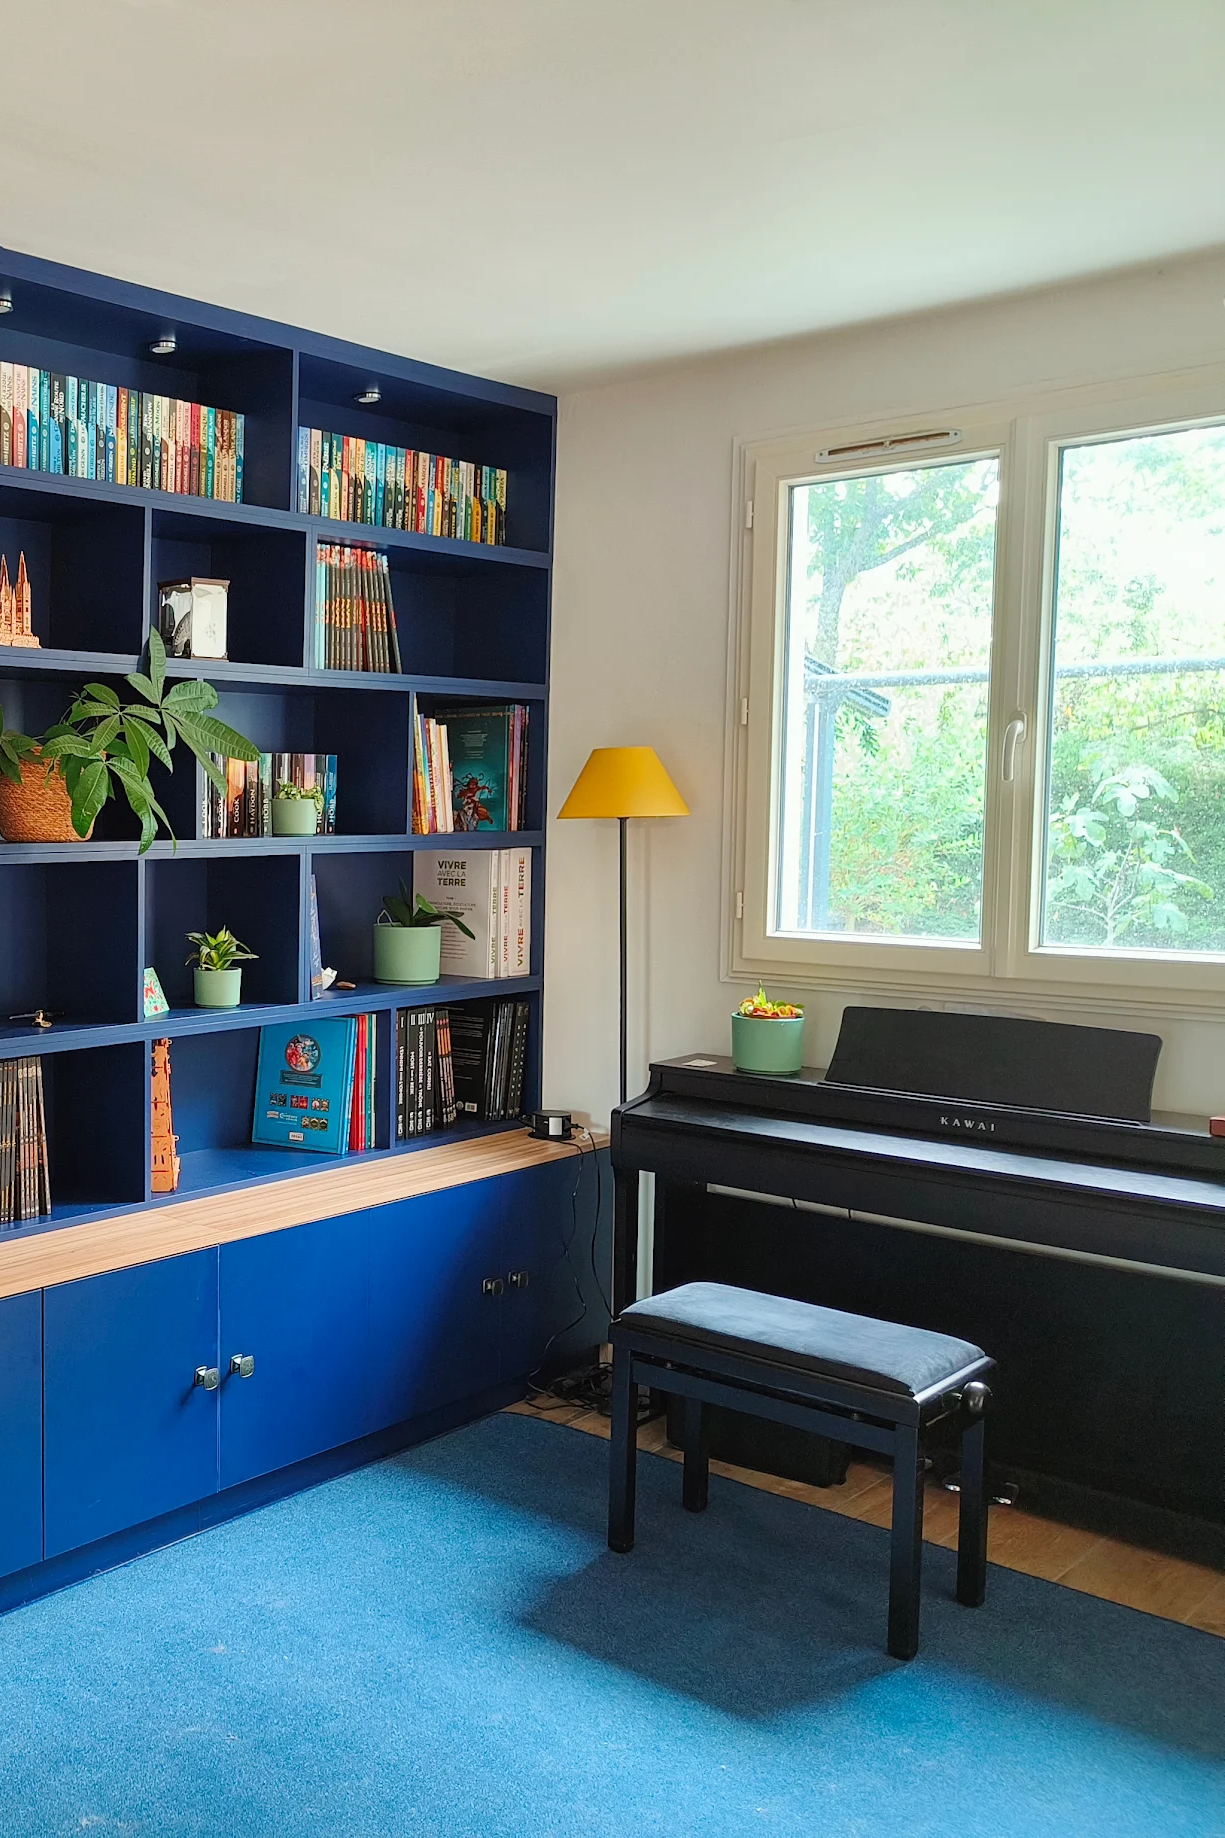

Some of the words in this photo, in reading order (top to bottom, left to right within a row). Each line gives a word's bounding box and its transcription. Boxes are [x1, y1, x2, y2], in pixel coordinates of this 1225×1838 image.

[438, 861, 466, 869] VIVRE
[437, 878, 466, 886] TERRE
[427, 1013, 434, 1024] IV
[940, 1117, 995, 1131] KAWAI
